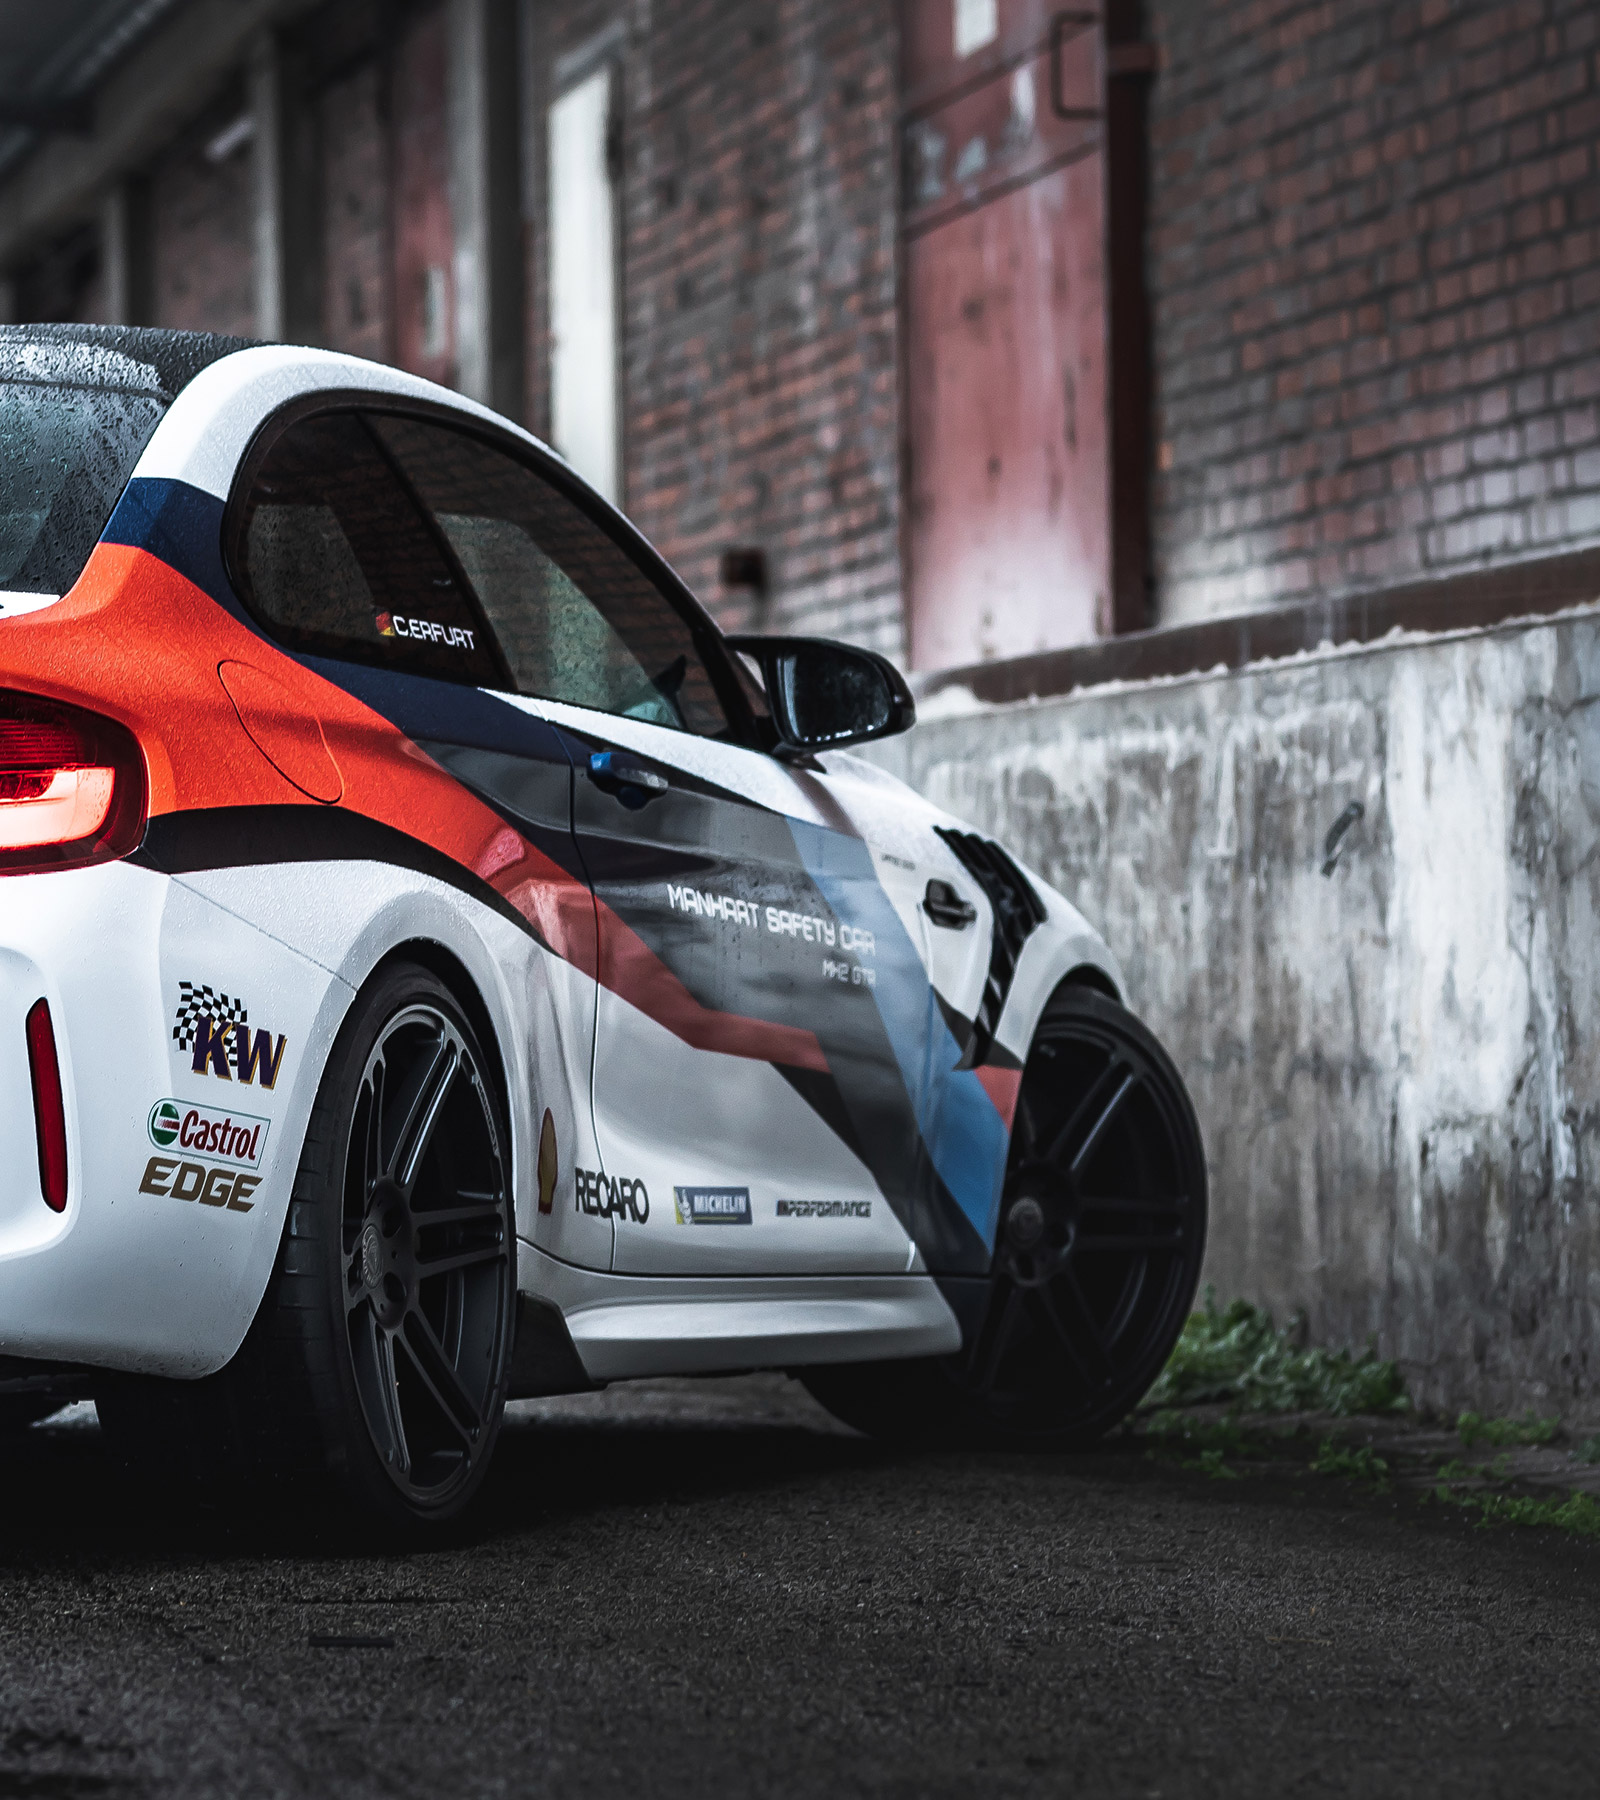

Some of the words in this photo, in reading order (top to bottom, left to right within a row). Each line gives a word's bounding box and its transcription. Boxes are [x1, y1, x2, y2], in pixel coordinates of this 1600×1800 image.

[392, 615, 475, 650] C.ERFURT
[666, 884, 759, 929] MANHART
[766, 907, 836, 946] SAFETY
[840, 924, 876, 956] CAR
[191, 1015, 288, 1090] KW
[179, 1109, 261, 1161] Castrol
[138, 1156, 263, 1213] EDGE
[575, 1167, 650, 1225] RECARO
[693, 1194, 747, 1214] MICHELIN
